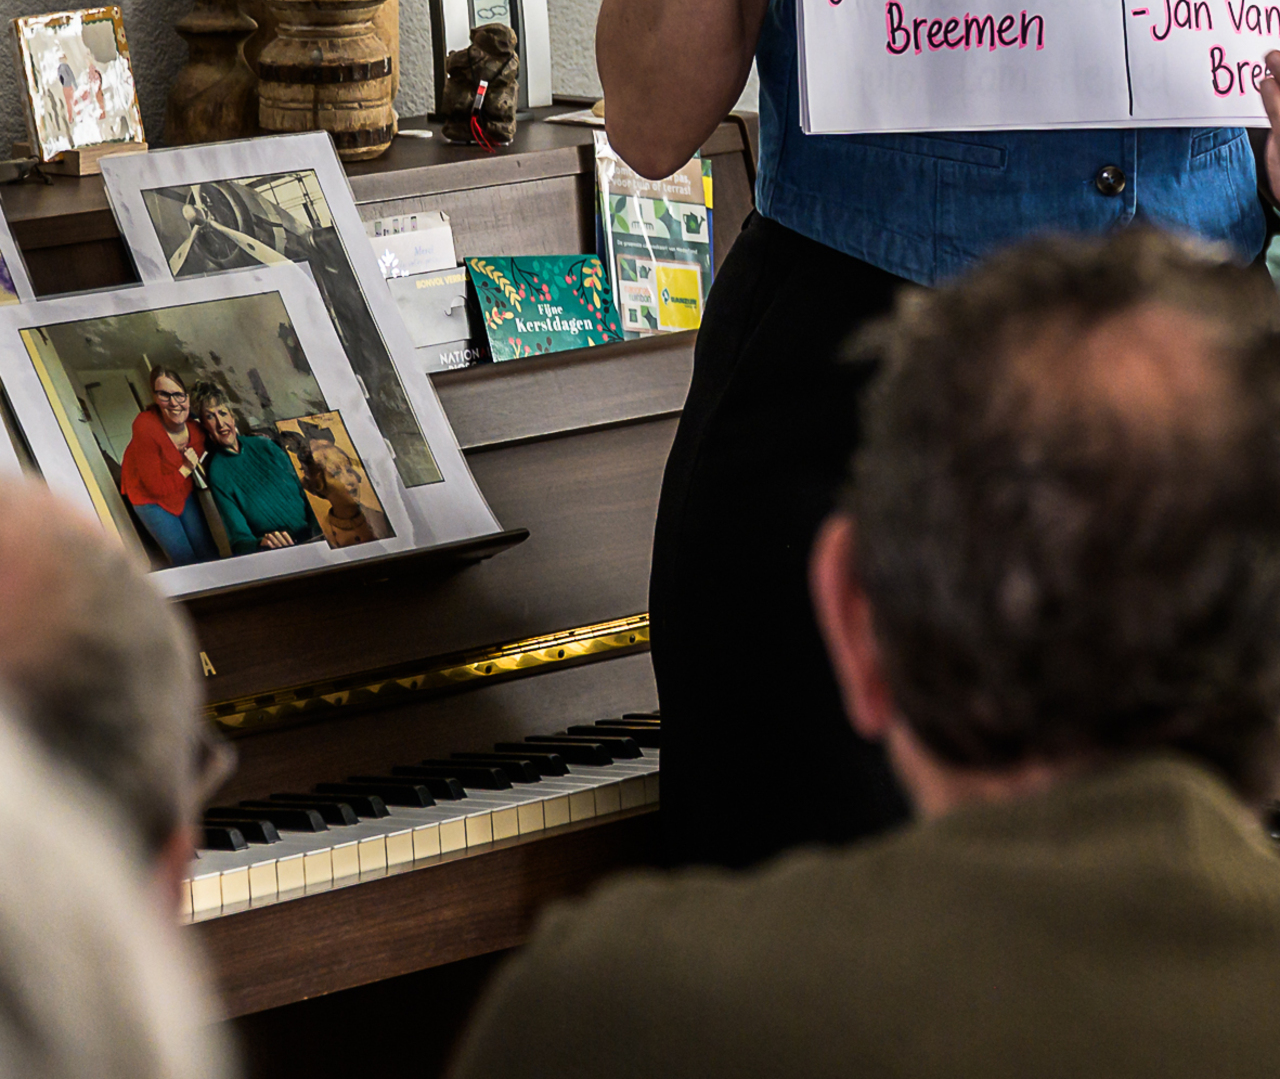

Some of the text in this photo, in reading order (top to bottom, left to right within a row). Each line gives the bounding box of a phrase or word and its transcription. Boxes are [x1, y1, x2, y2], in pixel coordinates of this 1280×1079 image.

[885, 0, 1045, 56] Breemen
[537, 303, 563, 318] Fijne
[515, 315, 594, 335] Kerstdagen
